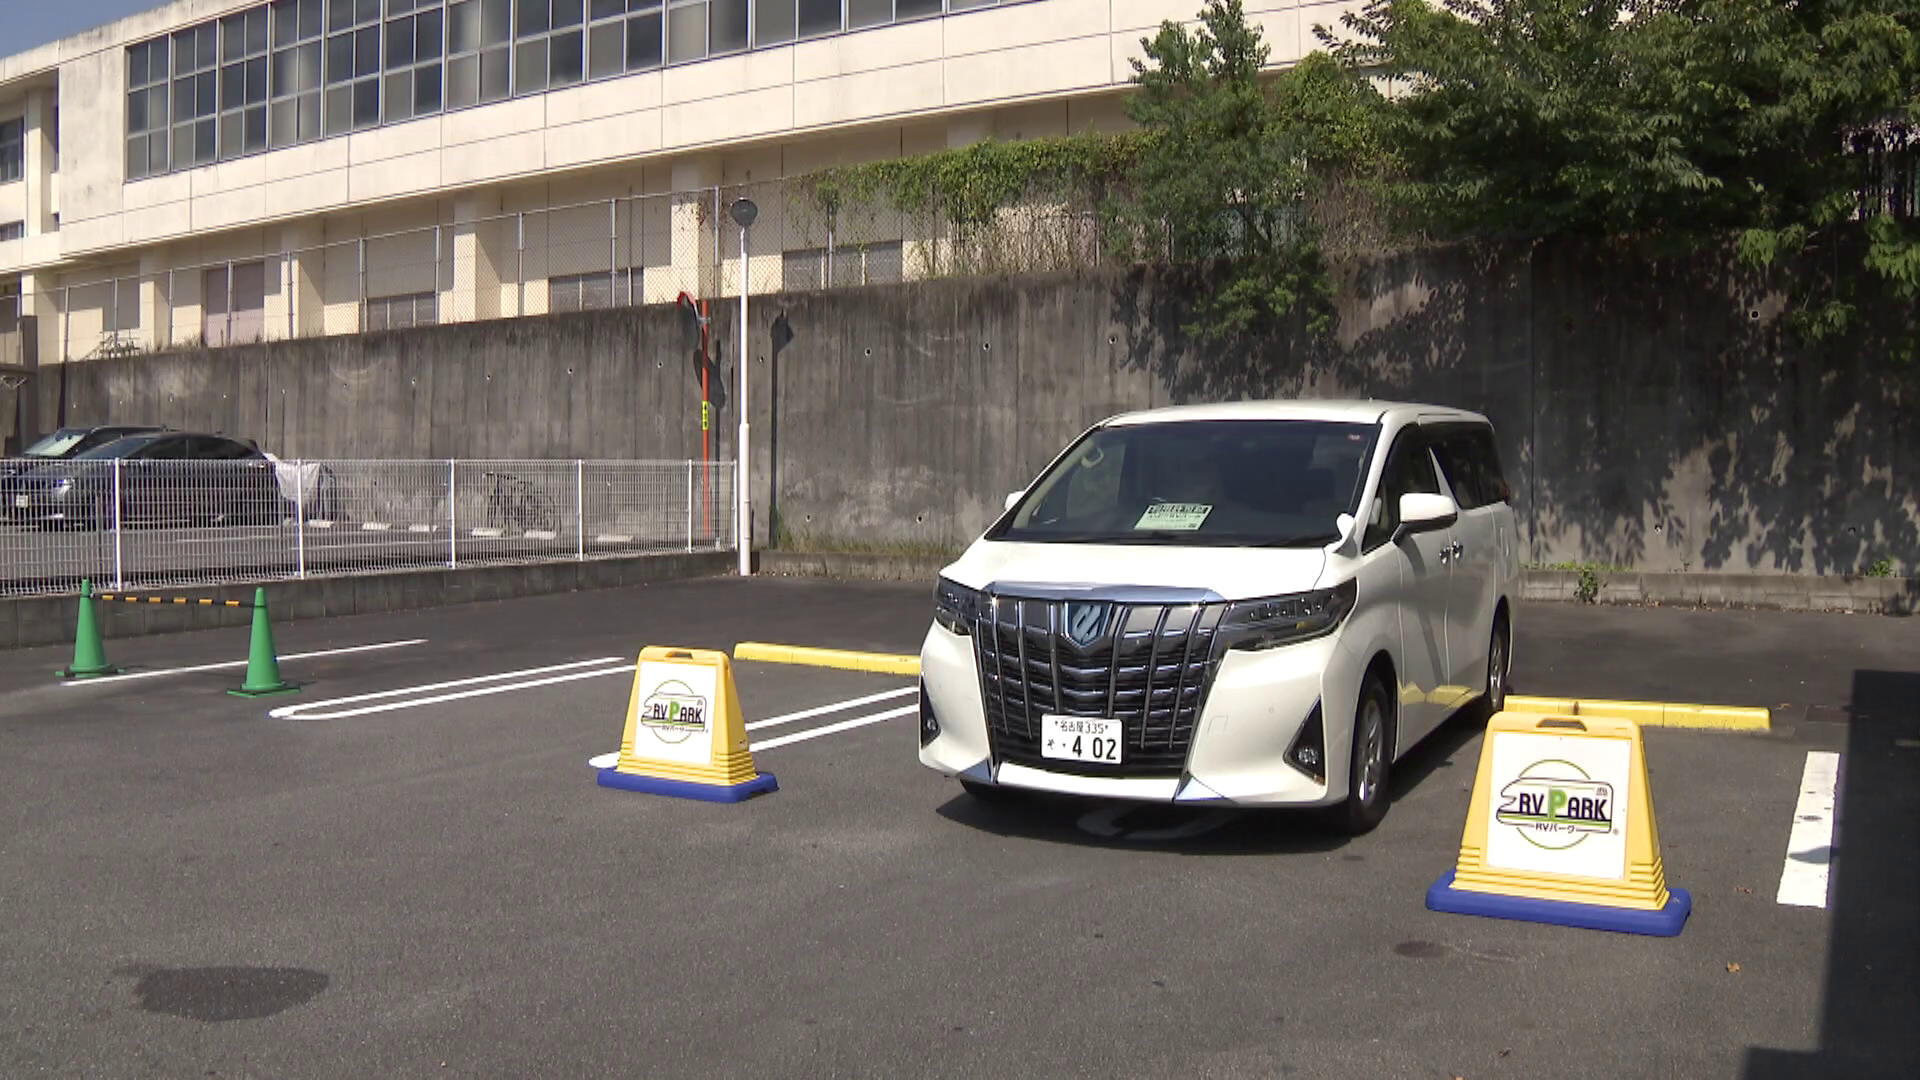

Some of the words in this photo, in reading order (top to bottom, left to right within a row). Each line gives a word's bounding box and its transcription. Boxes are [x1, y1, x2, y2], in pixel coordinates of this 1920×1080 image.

[653, 703, 668, 720] RV
[670, 701, 703, 723] PARK
[1520, 792, 1544, 815] RV
[1548, 789, 1608, 820] PARK
[1535, 823, 1576, 834] RVパーク
